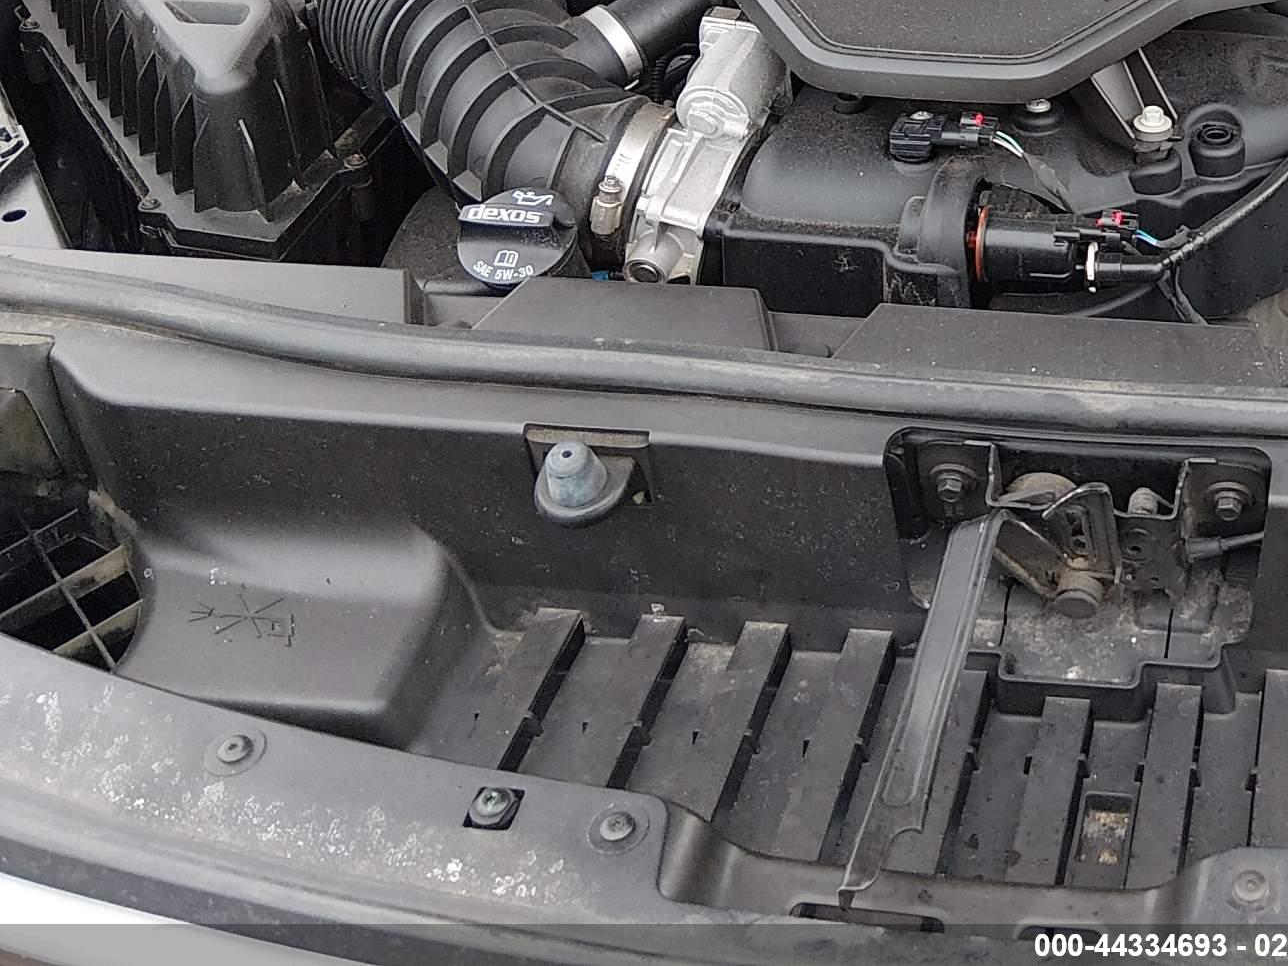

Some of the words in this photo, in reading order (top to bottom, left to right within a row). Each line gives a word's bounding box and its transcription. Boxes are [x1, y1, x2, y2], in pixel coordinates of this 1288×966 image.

[468, 204, 544, 223] dexos
[474, 261, 493, 277] SAE
[495, 265, 534, 280] 5W-30
